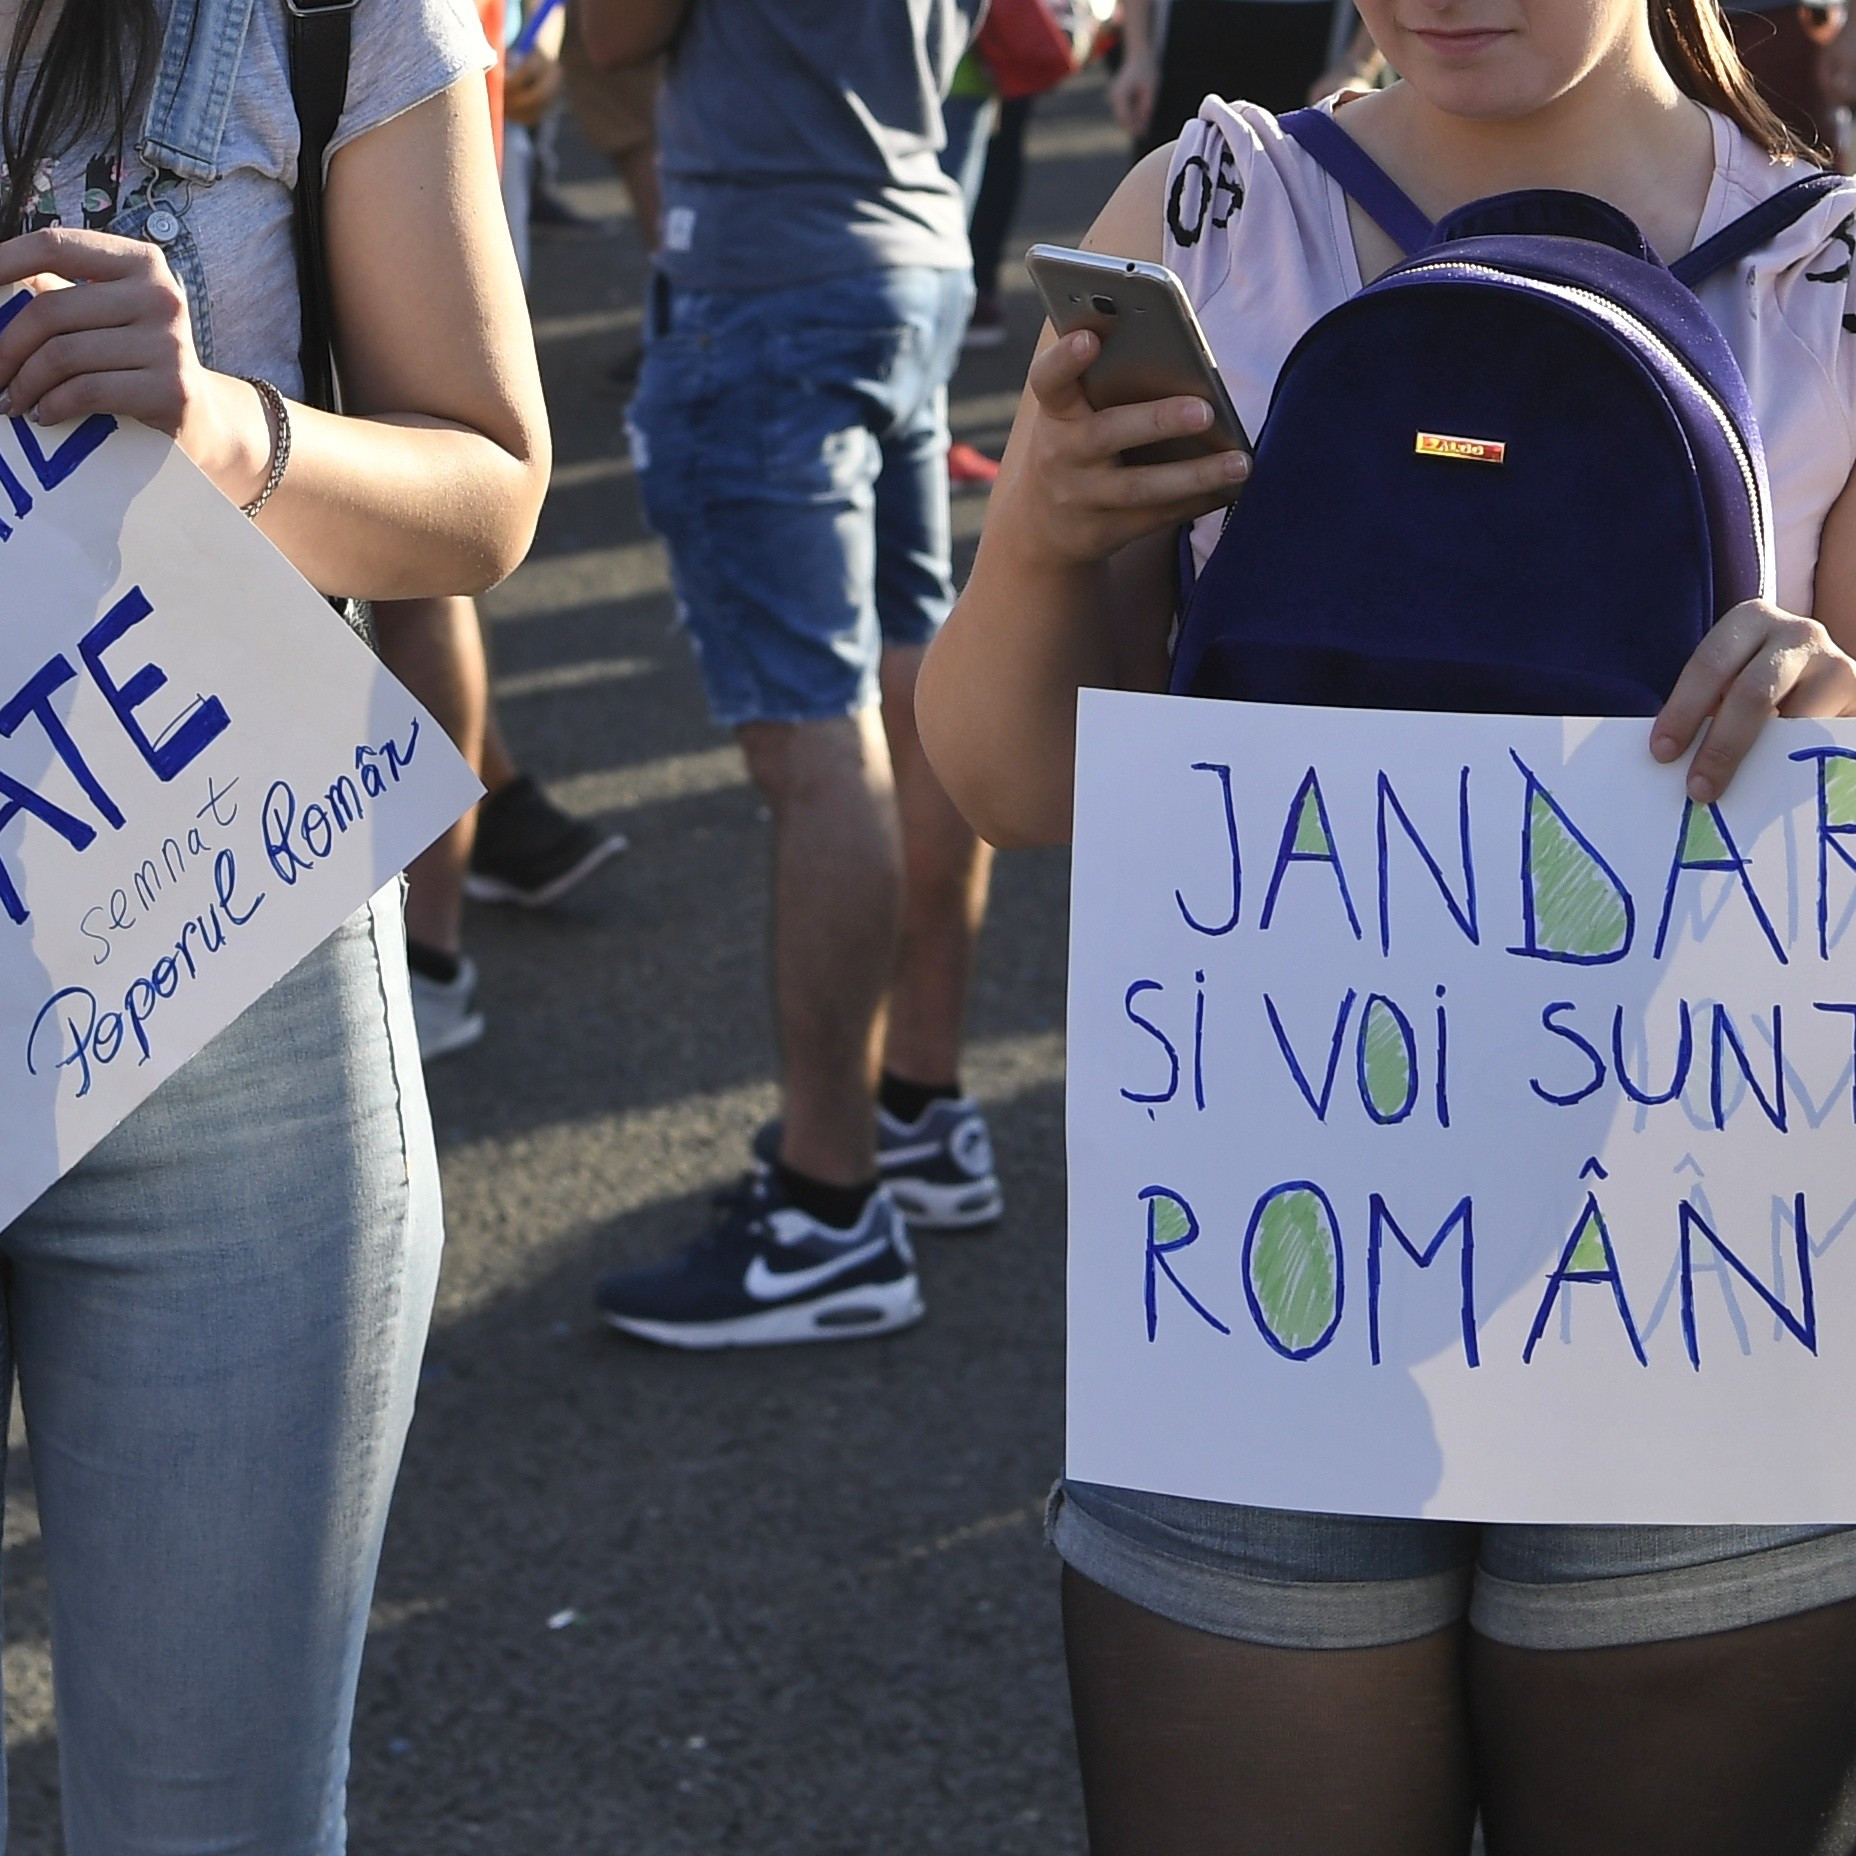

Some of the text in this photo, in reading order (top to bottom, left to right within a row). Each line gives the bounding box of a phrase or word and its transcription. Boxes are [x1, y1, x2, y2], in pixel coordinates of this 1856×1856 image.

[80, 776, 240, 966] semnat
[26, 848, 266, 1099] Poporul
[1263, 983, 1451, 1129] VOI
